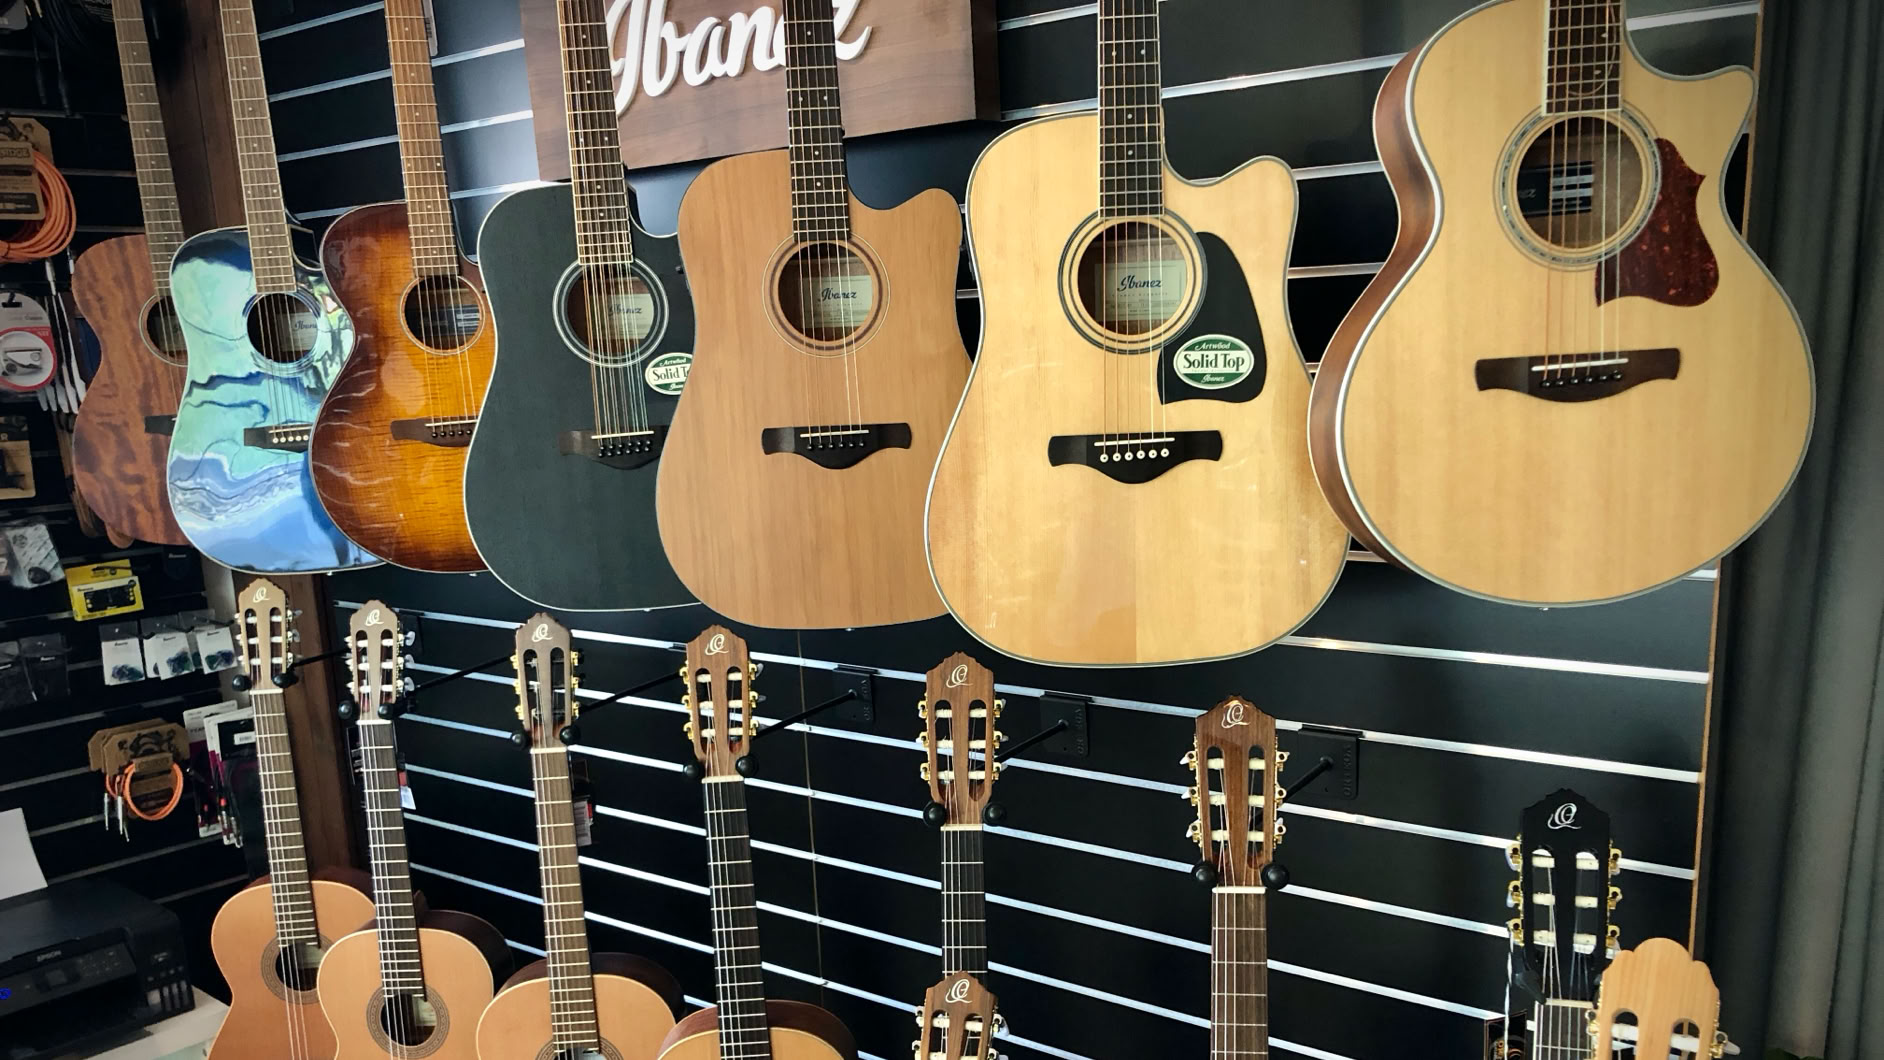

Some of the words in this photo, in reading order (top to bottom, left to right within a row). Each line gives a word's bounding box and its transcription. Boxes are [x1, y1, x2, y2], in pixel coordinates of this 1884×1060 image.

[607, 0, 873, 118] Ibanz
[1117, 274, 1162, 291] Ibanez
[817, 287, 857, 302] Ibanez
[1183, 353, 1218, 369] Solid
[1220, 353, 1245, 371] Top
[652, 367, 680, 381] Solid
